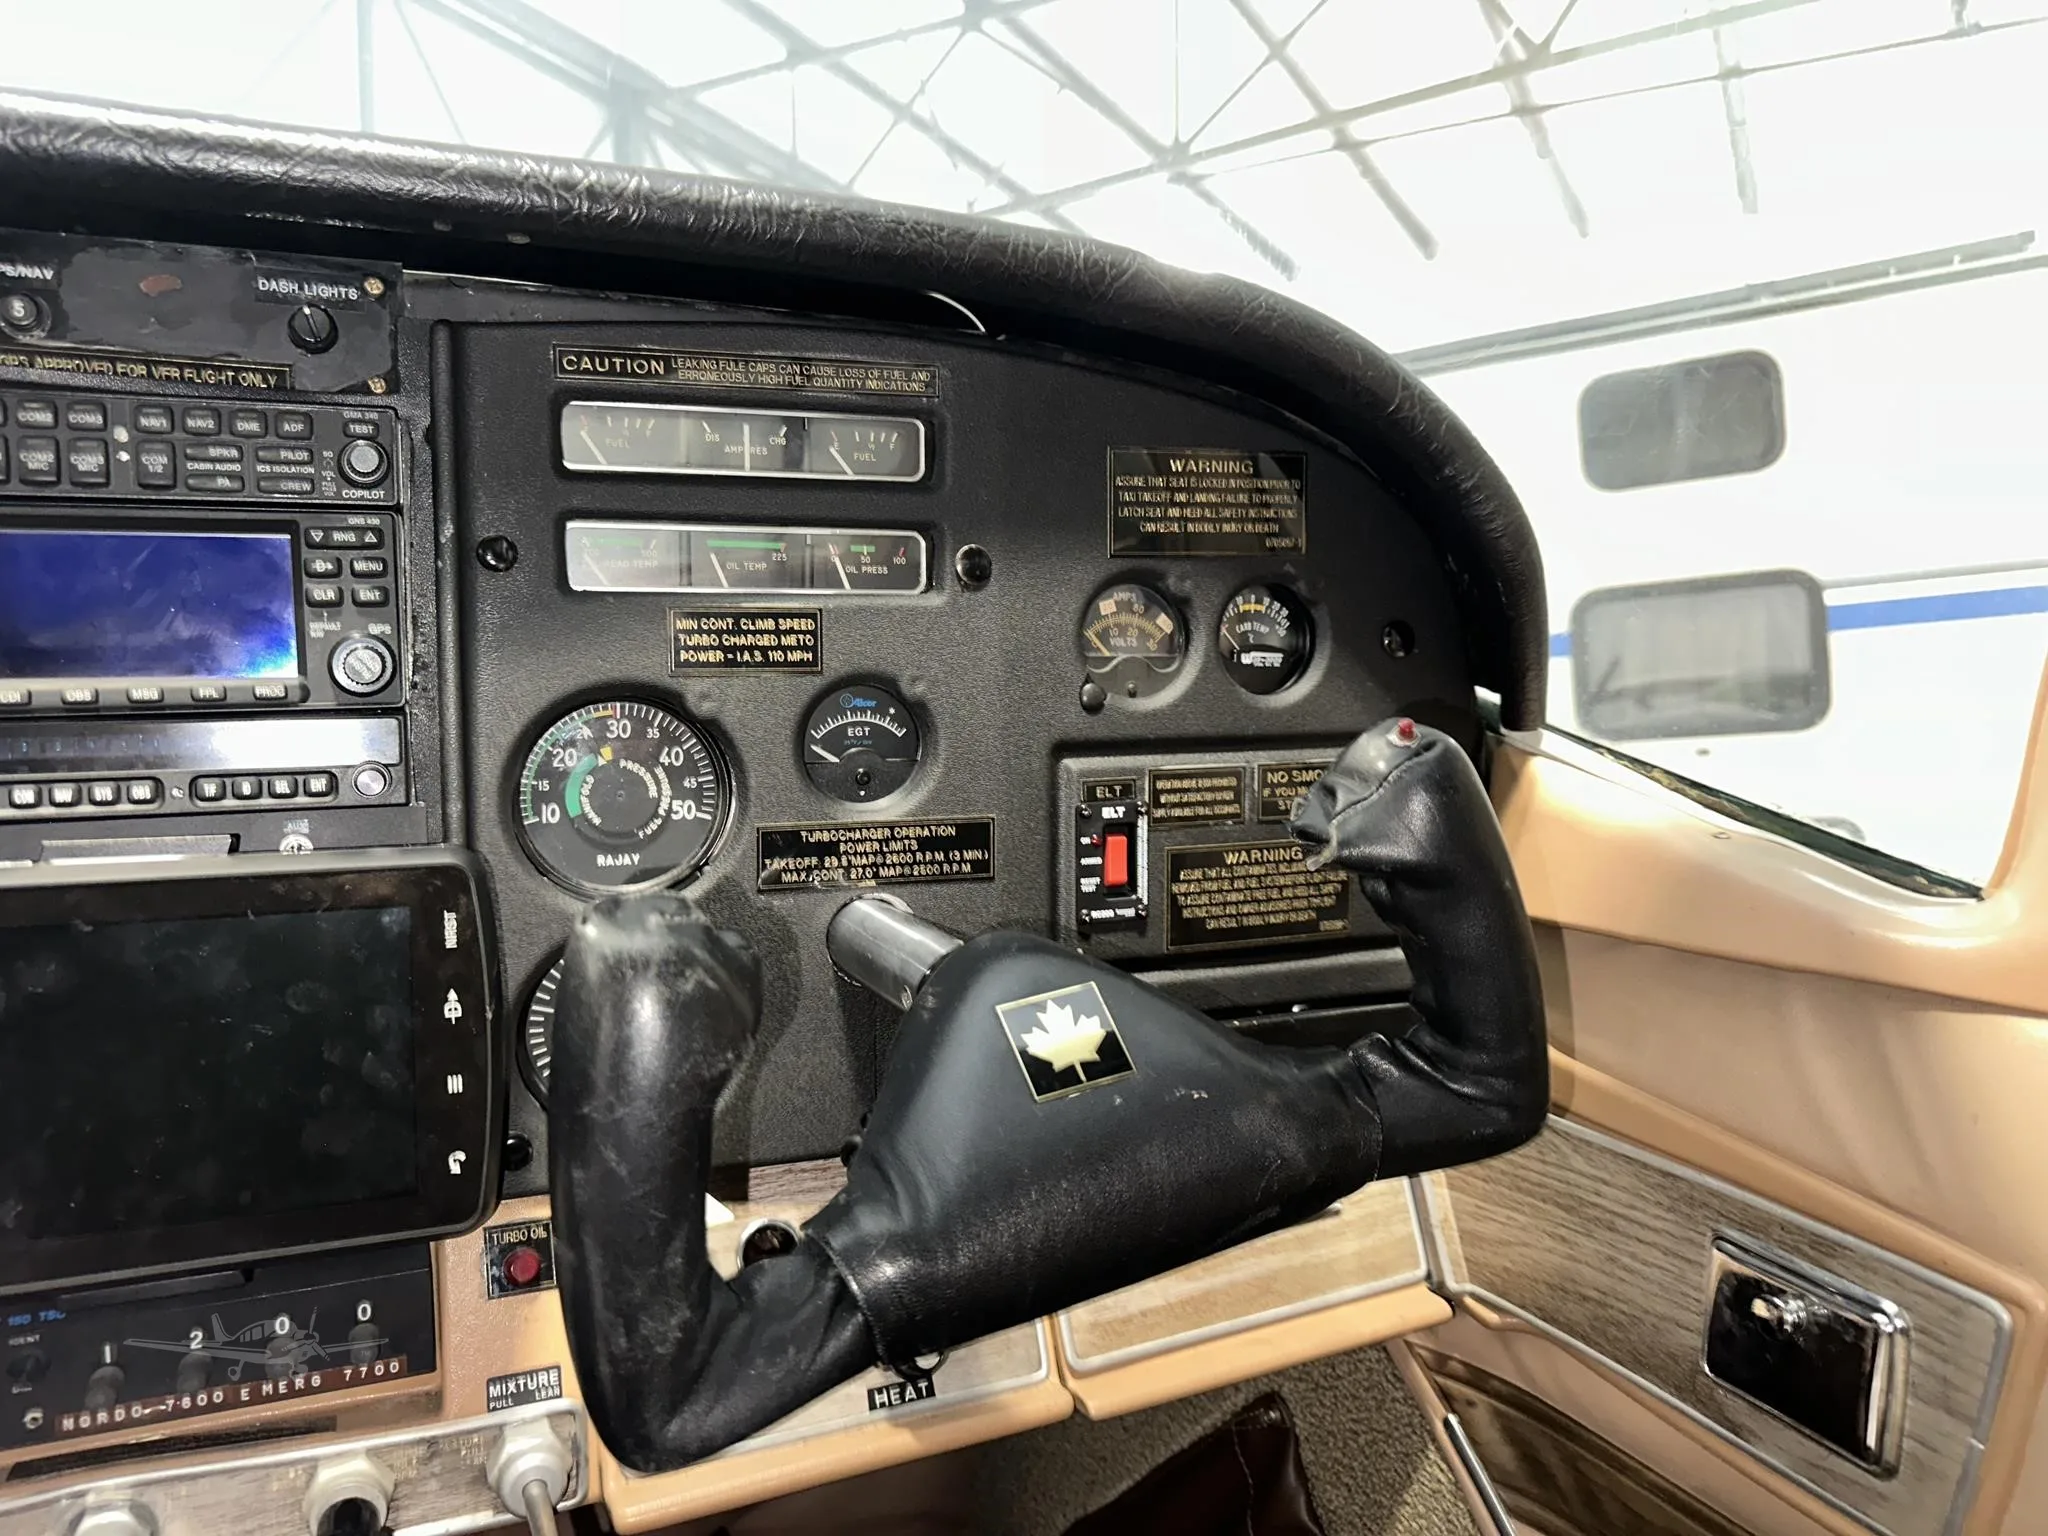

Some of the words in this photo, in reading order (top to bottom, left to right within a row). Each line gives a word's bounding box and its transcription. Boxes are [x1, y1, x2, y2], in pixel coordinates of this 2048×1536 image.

[257, 276, 299, 294] DASH
[304, 282, 358, 300] LIGHTS
[562, 355, 665, 375] CAUTION
[671, 357, 717, 370] LEAKING
[720, 360, 746, 372] FULE
[749, 362, 776, 373] CAPS
[779, 364, 800, 374] CAN
[803, 365, 836, 376] CAUSE
[840, 367, 866, 378] LOSS
[868, 368, 882, 379] OF
[884, 369, 908, 381] FUEL
[911, 370, 931, 382] AND
[116, 363, 147, 378] FOR
[152, 365, 180, 381] VFR
[184, 366, 235, 385] FLIGHT
[238, 370, 278, 389] ONLY
[678, 369, 756, 383] ERRONEOUSLY
[758, 374, 784, 385] HIGH
[785, 375, 811, 386] FUEL
[813, 377, 862, 389] QUANTITY
[866, 379, 926, 392] INDICATIONS
[17, 409, 53, 422] COM2
[68, 410, 104, 424] COM3
[139, 414, 167, 428] NAV1
[187, 417, 215, 429] NAV2
[237, 421, 261, 432] DME
[283, 422, 304, 432] ADF
[349, 424, 375, 434] TEST
[705, 434, 720, 442] DIS
[769, 437, 787, 446] CHG
[208, 448, 239, 458] SPKR
[280, 451, 309, 460] PILOT
[724, 445, 768, 455] AMPRES
[20, 451, 55, 463] COM2
[141, 454, 168, 465] COM
[854, 453, 877, 462] FUEL
[27, 461, 50, 471] MIC
[187, 463, 214, 471] CABIN
[215, 463, 242, 472] AUDIO
[257, 465, 271, 473] ICS
[272, 465, 315, 475] ISOLATION
[1169, 459, 1254, 474] WARNING
[280, 480, 312, 491] CREW
[1148, 475, 1167, 487] THAT
[342, 489, 385, 499] COPILOT
[332, 531, 356, 543] RNG
[772, 553, 788, 561] 225
[893, 557, 906, 565] 100
[353, 560, 383, 572] MENU
[726, 562, 740, 570] OIL
[743, 562, 768, 571] TEMP
[845, 566, 858, 574] OIL
[862, 566, 888, 575] PRESS
[312, 589, 336, 601] CLR
[359, 589, 381, 601] ENT
[368, 623, 392, 635] GPS
[676, 618, 698, 630] MIN
[700, 618, 738, 630] CONT.
[740, 618, 776, 630] CLIMB
[778, 618, 816, 631] SPEED
[678, 633, 719, 647] TURBO
[721, 633, 779, 647] CHARGED
[781, 633, 815, 647] METO
[680, 650, 725, 663] POWER
[768, 650, 785, 663] 110
[786, 650, 813, 663] MPH
[131, 687, 159, 700] MSG
[255, 685, 285, 698] PROC
[606, 719, 631, 739] 30
[646, 728, 660, 739] 35
[847, 727, 871, 737] EGT
[552, 748, 578, 767] 20
[659, 746, 684, 766] 40
[1267, 771, 1289, 784] NO
[538, 780, 549, 791] 15
[683, 779, 697, 789] 45
[1096, 785, 1122, 799] ELT
[1274, 787, 1296, 797] YOU
[541, 802, 560, 824] 10
[671, 799, 696, 820] 50
[1101, 806, 1126, 819] ELT
[800, 828, 891, 843] TURBOCHARGER
[893, 825, 956, 838] OPERATION
[840, 840, 880, 854] POWER
[882, 839, 918, 852] LIMITS
[596, 853, 640, 867] RAJAY
[1223, 847, 1303, 865] WARNING
[879, 865, 903, 877] MAP
[491, 1229, 528, 1245] TURBO
[530, 1224, 548, 1239] OIL
[189, 1331, 204, 1350] 2
[274, 1316, 290, 1335] 0
[357, 1303, 372, 1321] 0
[489, 1368, 560, 1398] MIXTURE
[62, 1405, 143, 1431] NORDO
[344, 1362, 399, 1381] 7700
[874, 1382, 929, 1409] HEAT
[489, 1399, 514, 1411] PULL
